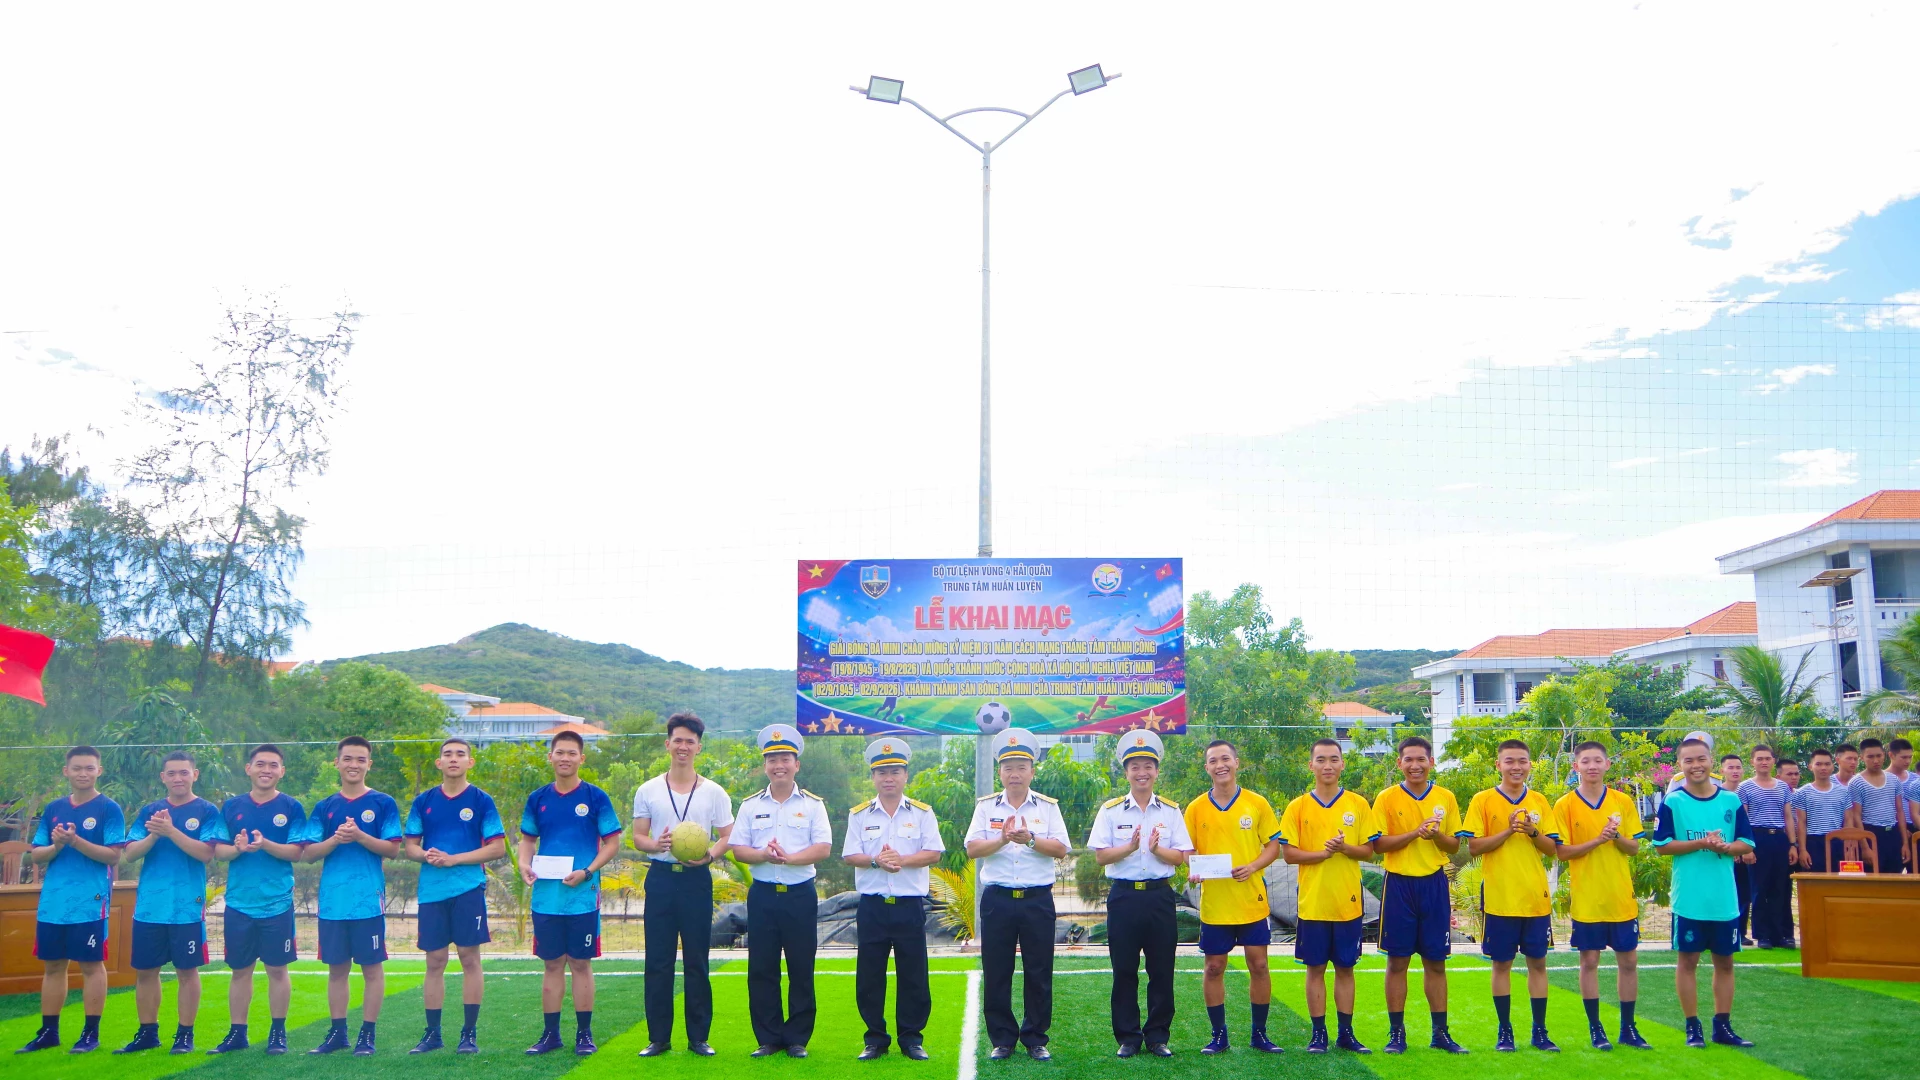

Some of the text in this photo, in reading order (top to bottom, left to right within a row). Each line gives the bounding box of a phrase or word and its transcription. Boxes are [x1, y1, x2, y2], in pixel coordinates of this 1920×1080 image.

[934, 563, 1051, 578] BỘ TƯ LỆNH VÙNG 4 HẢI QUÂN
[943, 579, 1041, 593] TRUNG TÂM HUẤN LUYỆN
[914, 596, 1071, 636] LỄ KHAI MẠC
[830, 638, 1156, 657] GIẢI BÓNG ĐÁ MINI CHÀO MỪNG KỶ NIỆM 81 NĂM CÁCH MẠNG THÁNG TÁM THÀNH CÔNG
[832, 662, 873, 677] (19/8/1945
[879, 662, 920, 677] 19/8/2026)
[921, 660, 932, 676] VÀ
[933, 659, 954, 676] QUỐC
[955, 660, 982, 675] KHÁNH
[984, 659, 1005, 675] NƯỚC
[1006, 660, 1028, 677] CỘNG
[1029, 659, 1046, 675] HOÀ
[1047, 659, 1058, 675] XÃ
[1059, 659, 1073, 677] HỘI
[1074, 657, 1090, 674] CHỦ
[1091, 659, 1116, 674] NGHĨA
[1117, 659, 1134, 677] VIỆT
[1135, 660, 1154, 674] NAM
[814, 683, 854, 697] (02/9/1945
[905, 680, 931, 696] KHÁNH
[932, 680, 958, 696] THÀNH
[960, 680, 976, 696] SÂN
[978, 680, 1000, 696] BÓNG
[1001, 680, 1012, 695] ĐÁ
[1013, 682, 1032, 695] MINI
[1033, 679, 1049, 695] CỦA
[1051, 682, 1077, 695] TRUNG
[1078, 680, 1095, 695] TÂM
[1096, 678, 1117, 695] HUẤN
[1119, 680, 1144, 697] LUYỆN
[1145, 679, 1166, 695] VÙNG
[1167, 682, 1173, 695] 4
[475, 916, 482, 930] 7
[87, 934, 96, 948] 4
[284, 939, 291, 953] 8
[372, 935, 379, 949] 11
[584, 933, 592, 947] 9
[1445, 932, 1450, 946] 2
[188, 940, 196, 954] 3
